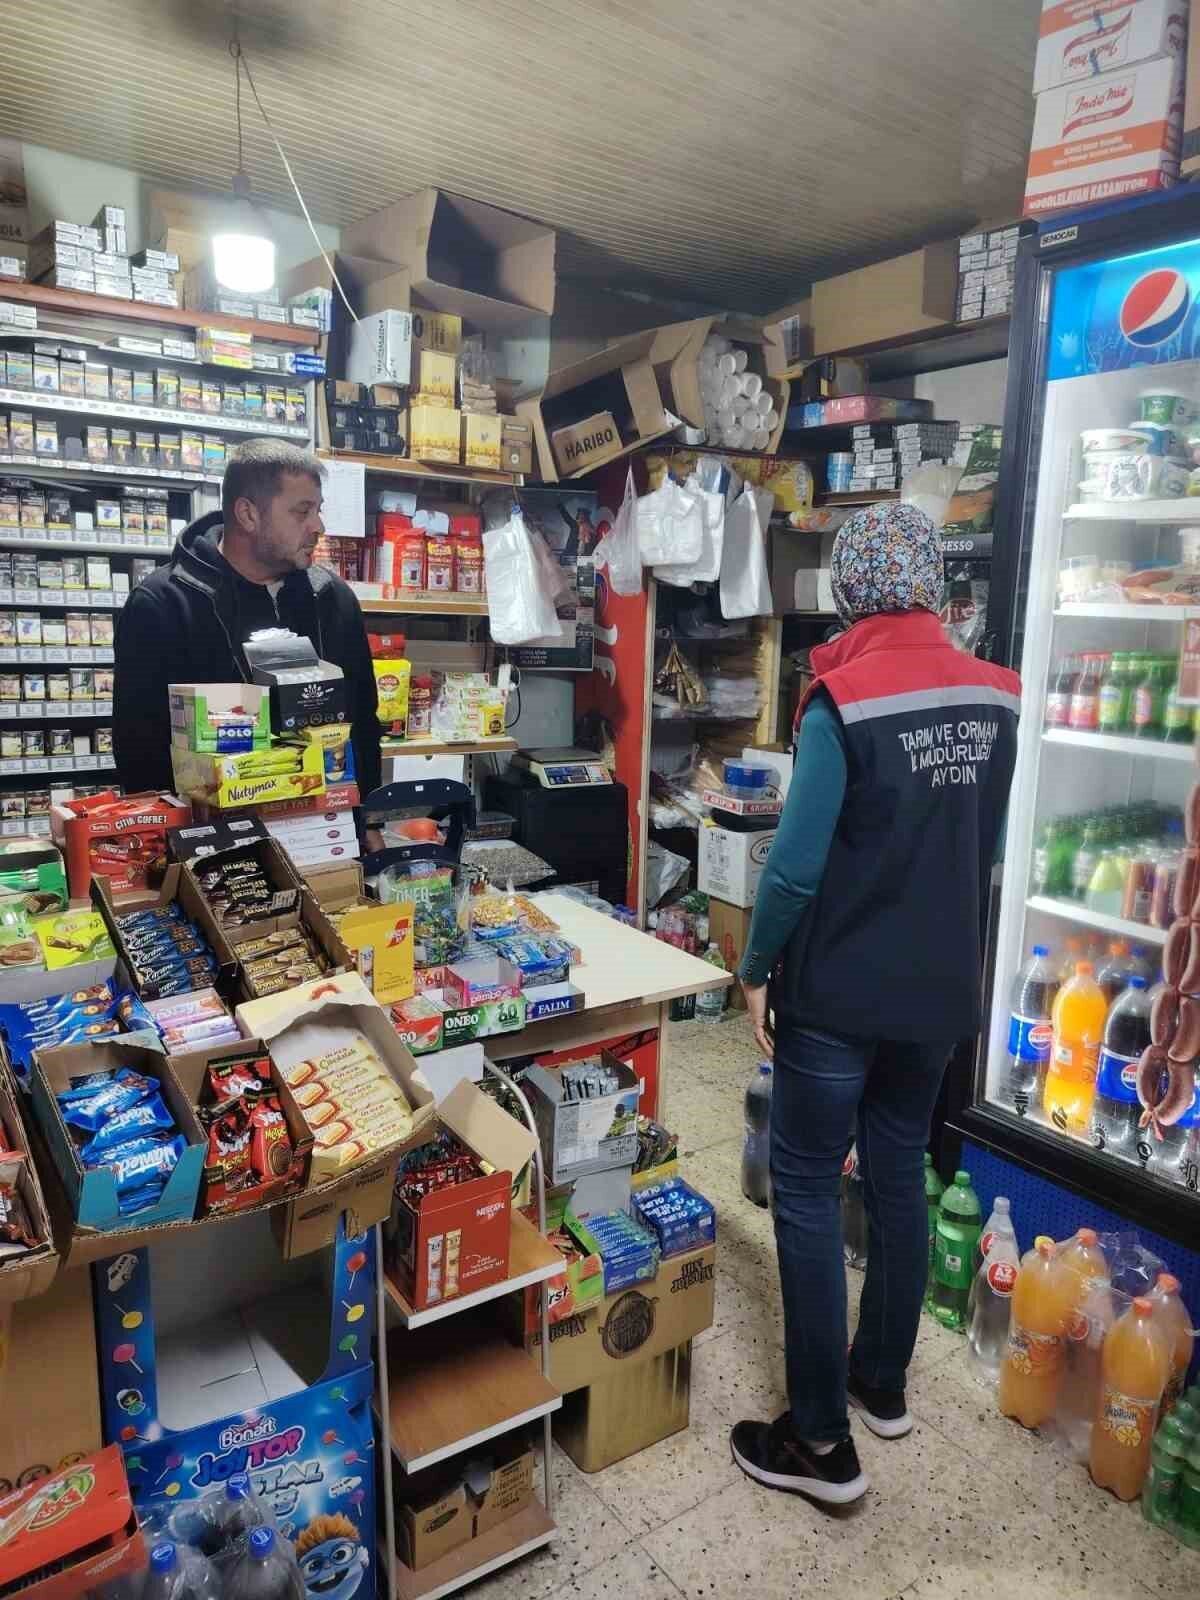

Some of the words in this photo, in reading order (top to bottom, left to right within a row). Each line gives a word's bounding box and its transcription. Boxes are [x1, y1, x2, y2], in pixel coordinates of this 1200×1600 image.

[565, 428, 613, 460] HARIBO
[218, 727, 252, 739] POLO
[934, 722, 953, 743] VE
[957, 720, 999, 743] ORMAN
[931, 764, 977, 788] AYDIN
[227, 778, 278, 803] Nutymax
[536, 999, 572, 1016] FALIM
[444, 1012, 480, 1030] ONEO
[219, 1417, 277, 1449] Bonart
